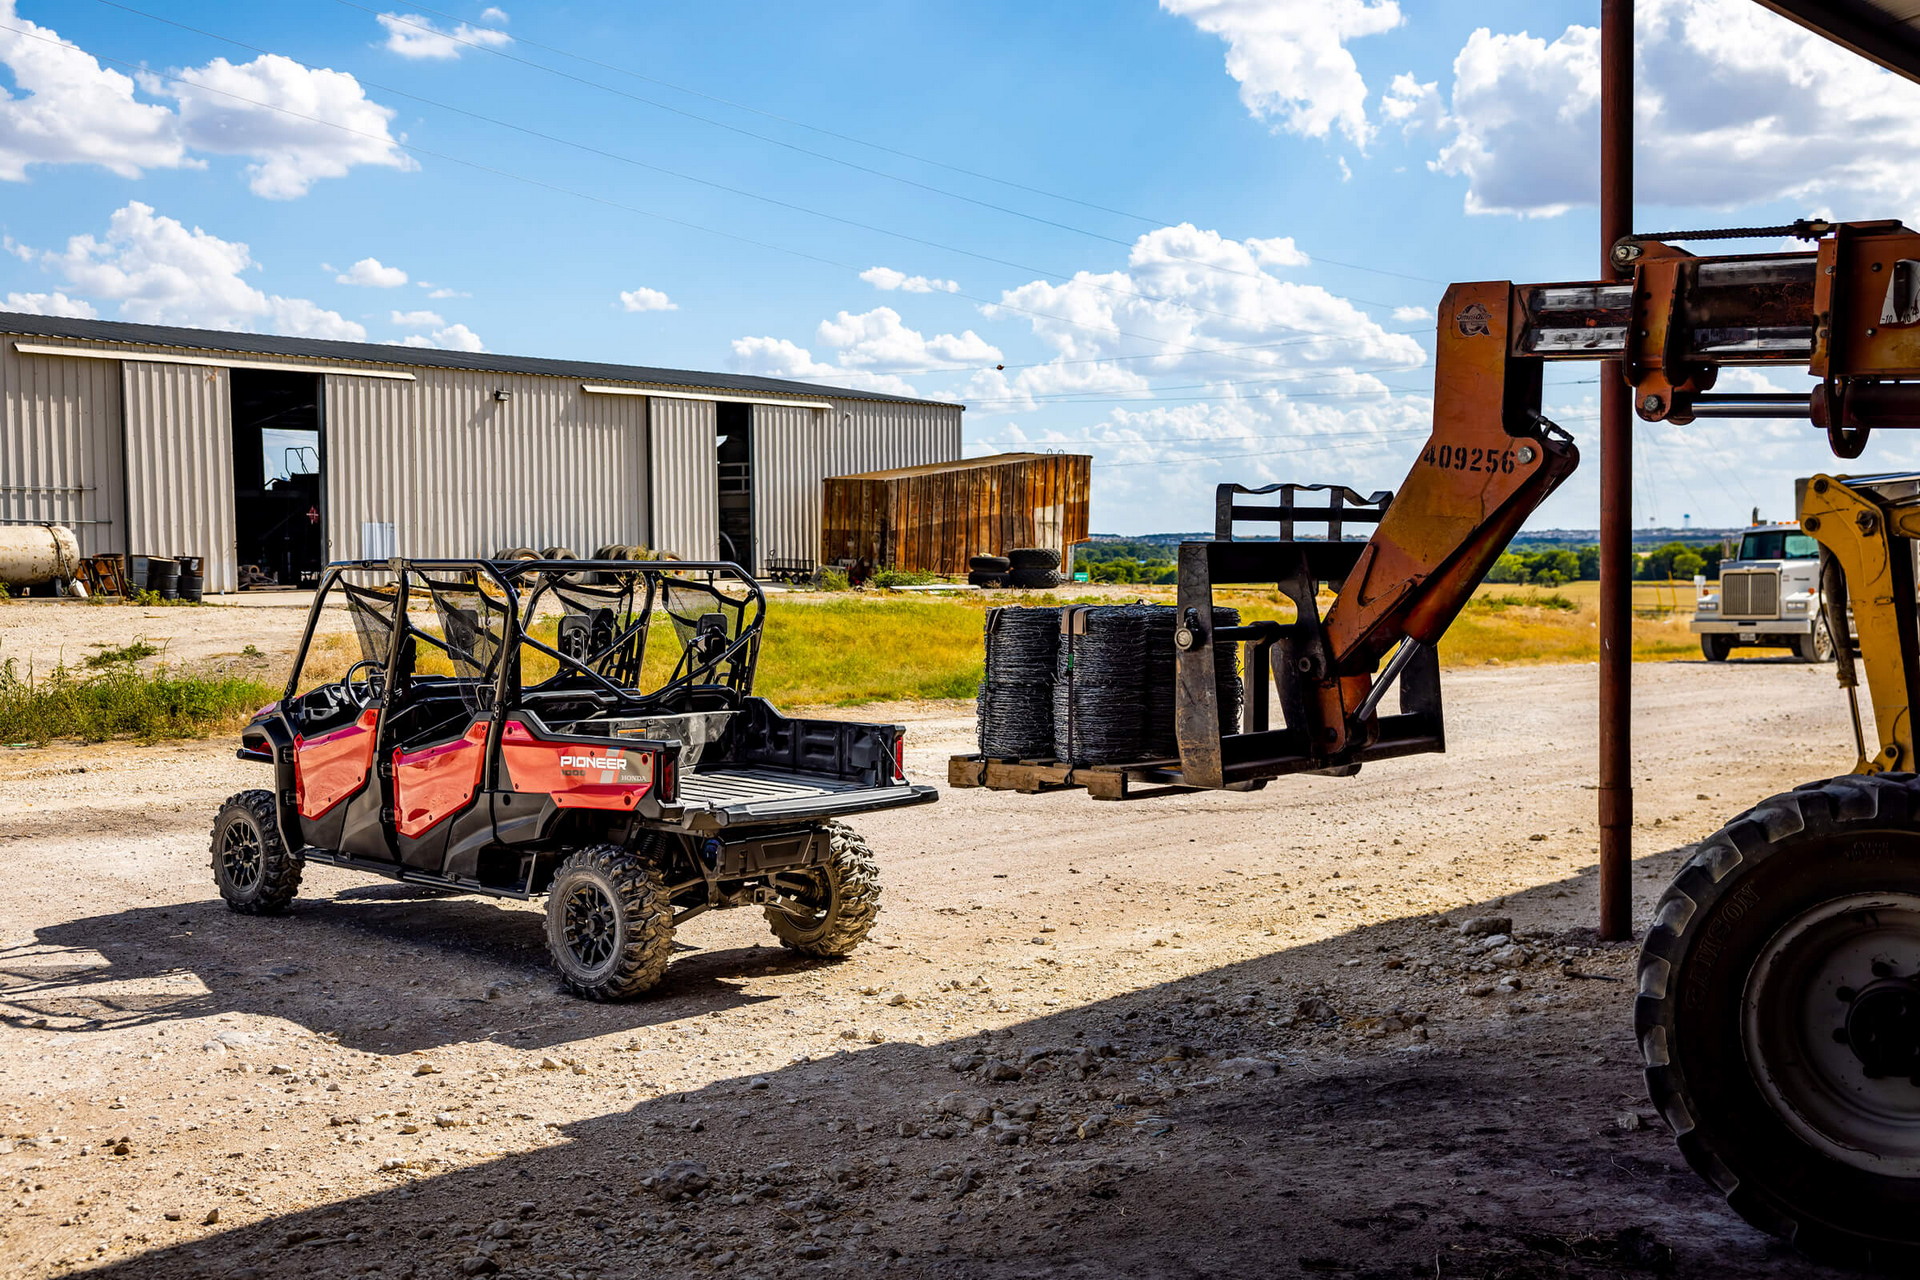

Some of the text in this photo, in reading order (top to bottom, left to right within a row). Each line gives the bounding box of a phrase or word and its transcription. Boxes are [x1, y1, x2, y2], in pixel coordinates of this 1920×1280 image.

[1881, 313, 1893, 323] -10
[1423, 445, 1515, 475] 409256
[560, 756, 627, 770] PIONEER
[561, 769, 586, 777] 1000
[621, 774, 647, 782] HONDA
[1683, 880, 1761, 1011] SAMSON
